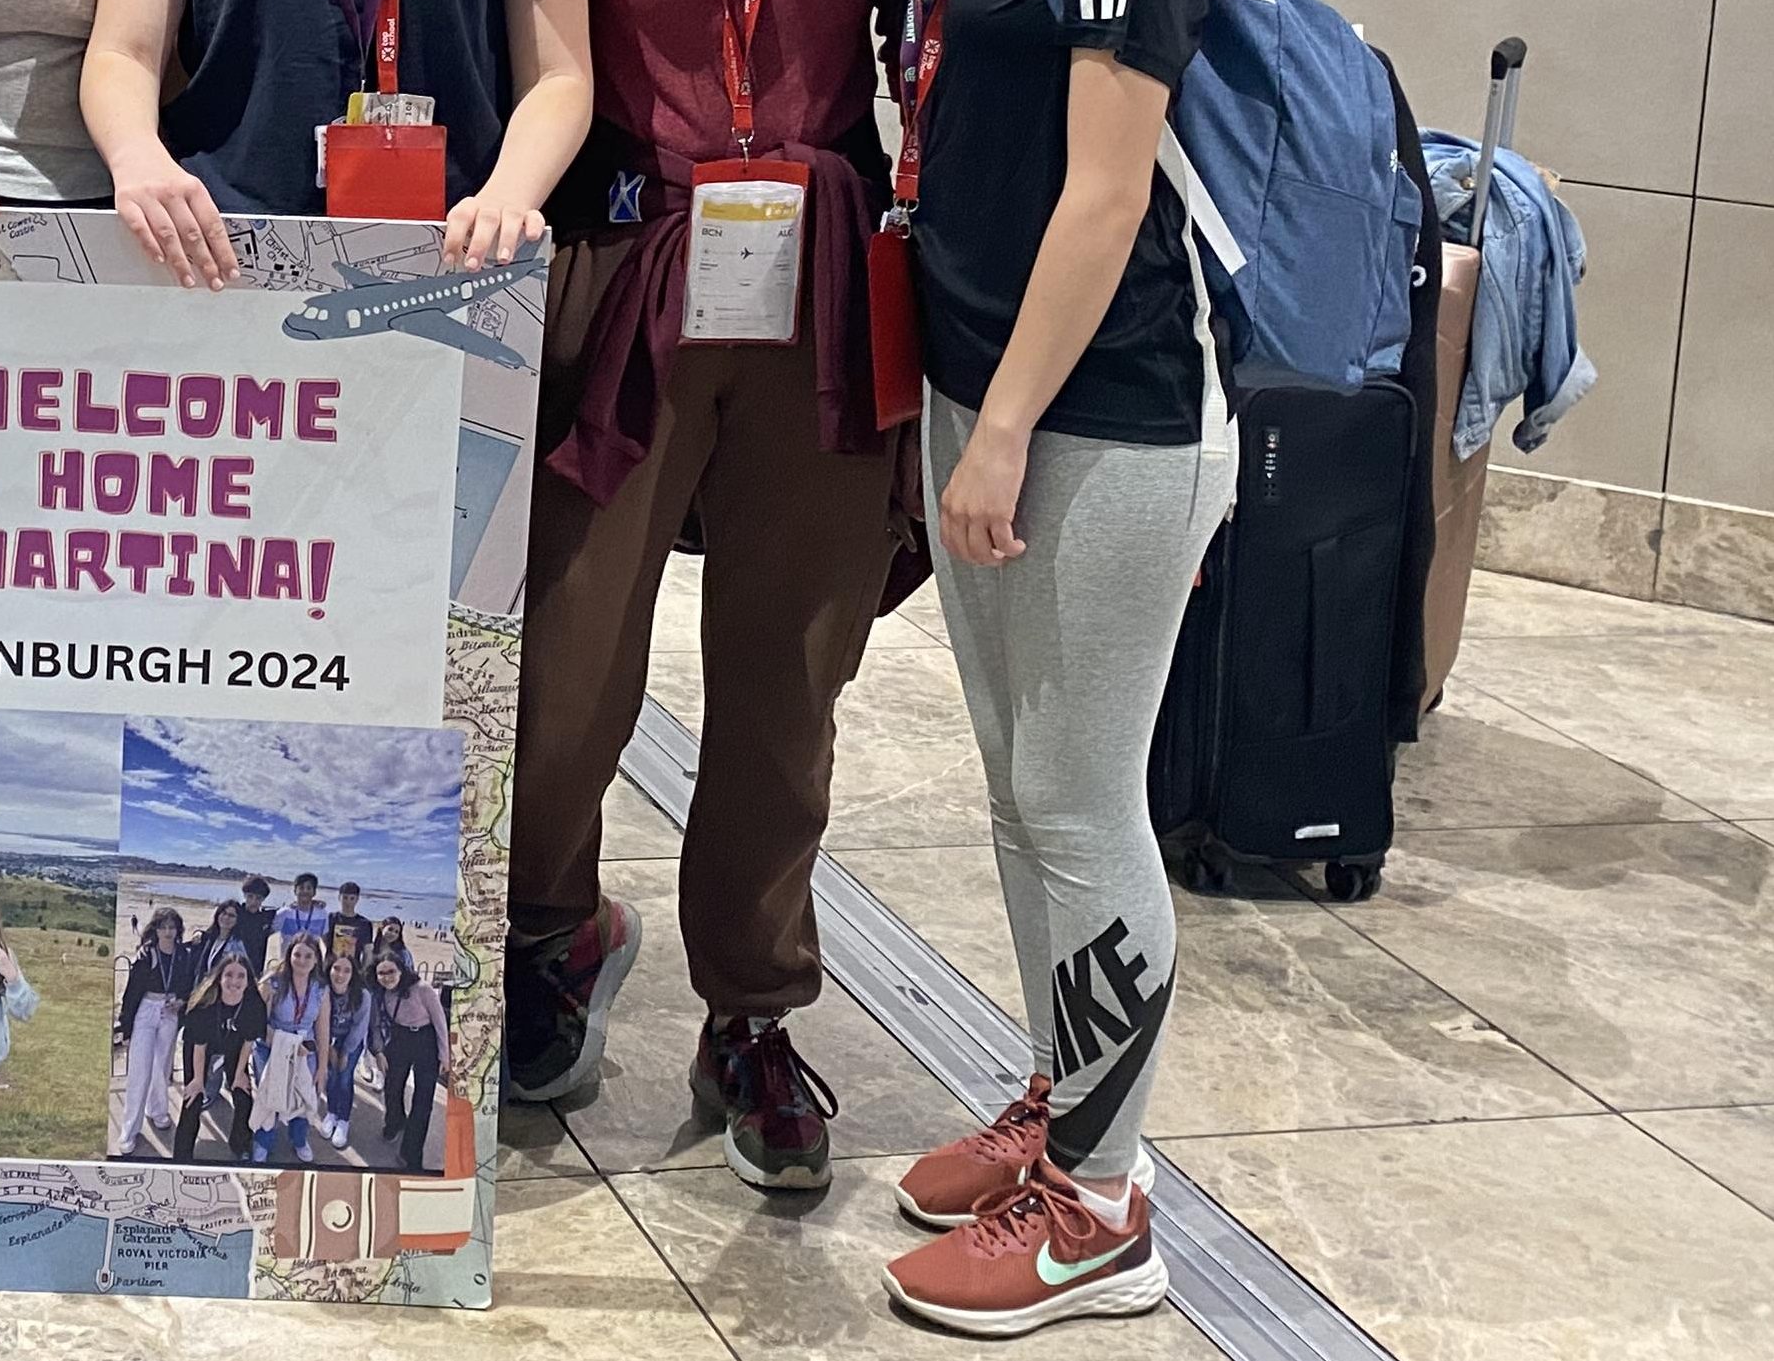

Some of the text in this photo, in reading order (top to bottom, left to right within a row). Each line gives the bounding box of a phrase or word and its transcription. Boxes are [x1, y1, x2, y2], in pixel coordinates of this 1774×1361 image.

[37, 450, 256, 520] HOME
[227, 649, 351, 691] 2024
[7, 1219, 63, 1247] Esplanade
[115, 1223, 177, 1237] Esplanade
[123, 1233, 173, 1244] Gardens
[117, 1247, 208, 1260] ROYAL VICTORIA
[144, 1261, 169, 1271] PIER
[114, 1276, 166, 1288] Pavilion
